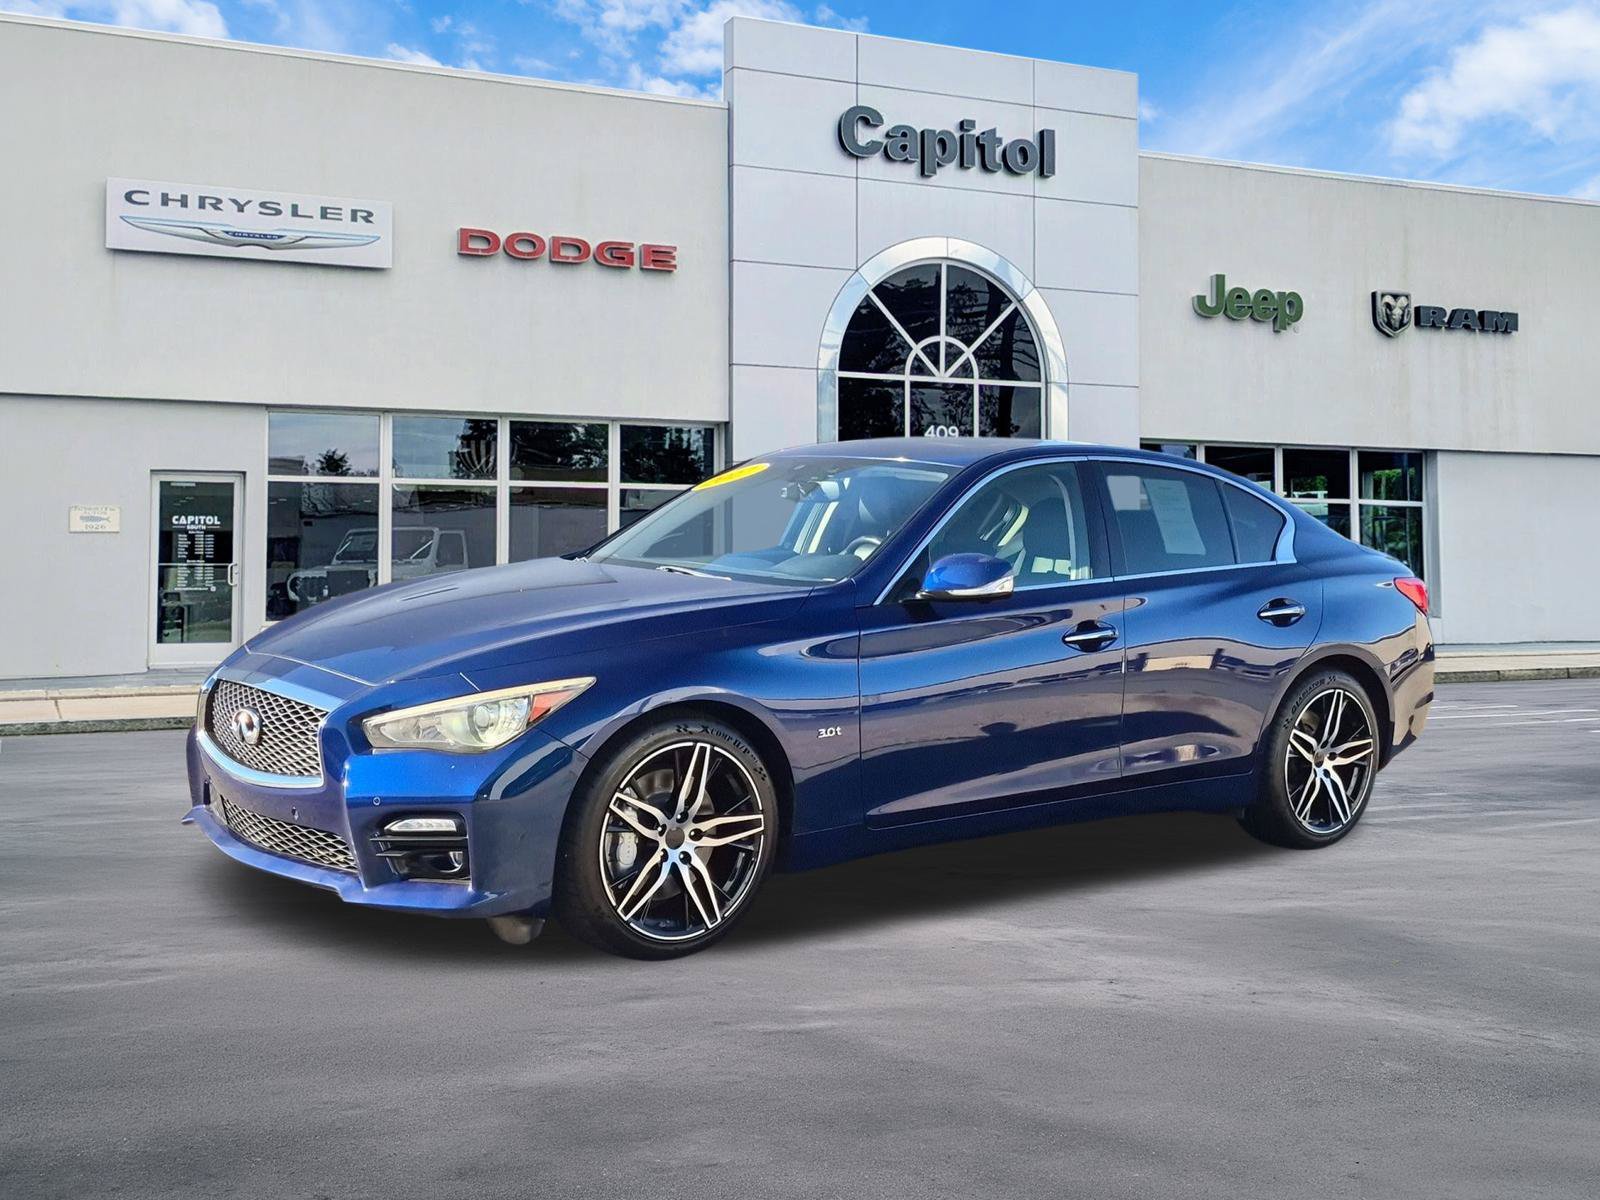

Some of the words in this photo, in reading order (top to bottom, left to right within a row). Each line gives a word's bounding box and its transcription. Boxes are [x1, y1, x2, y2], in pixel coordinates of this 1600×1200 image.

[838, 105, 1056, 177] Capitol
[124, 190, 375, 224] CHRYSLER
[457, 227, 678, 272] DODGE
[1192, 273, 1304, 333] Jeep
[1414, 304, 1519, 333] RAM
[924, 424, 960, 438] 409
[172, 515, 221, 525] CAPITOL
